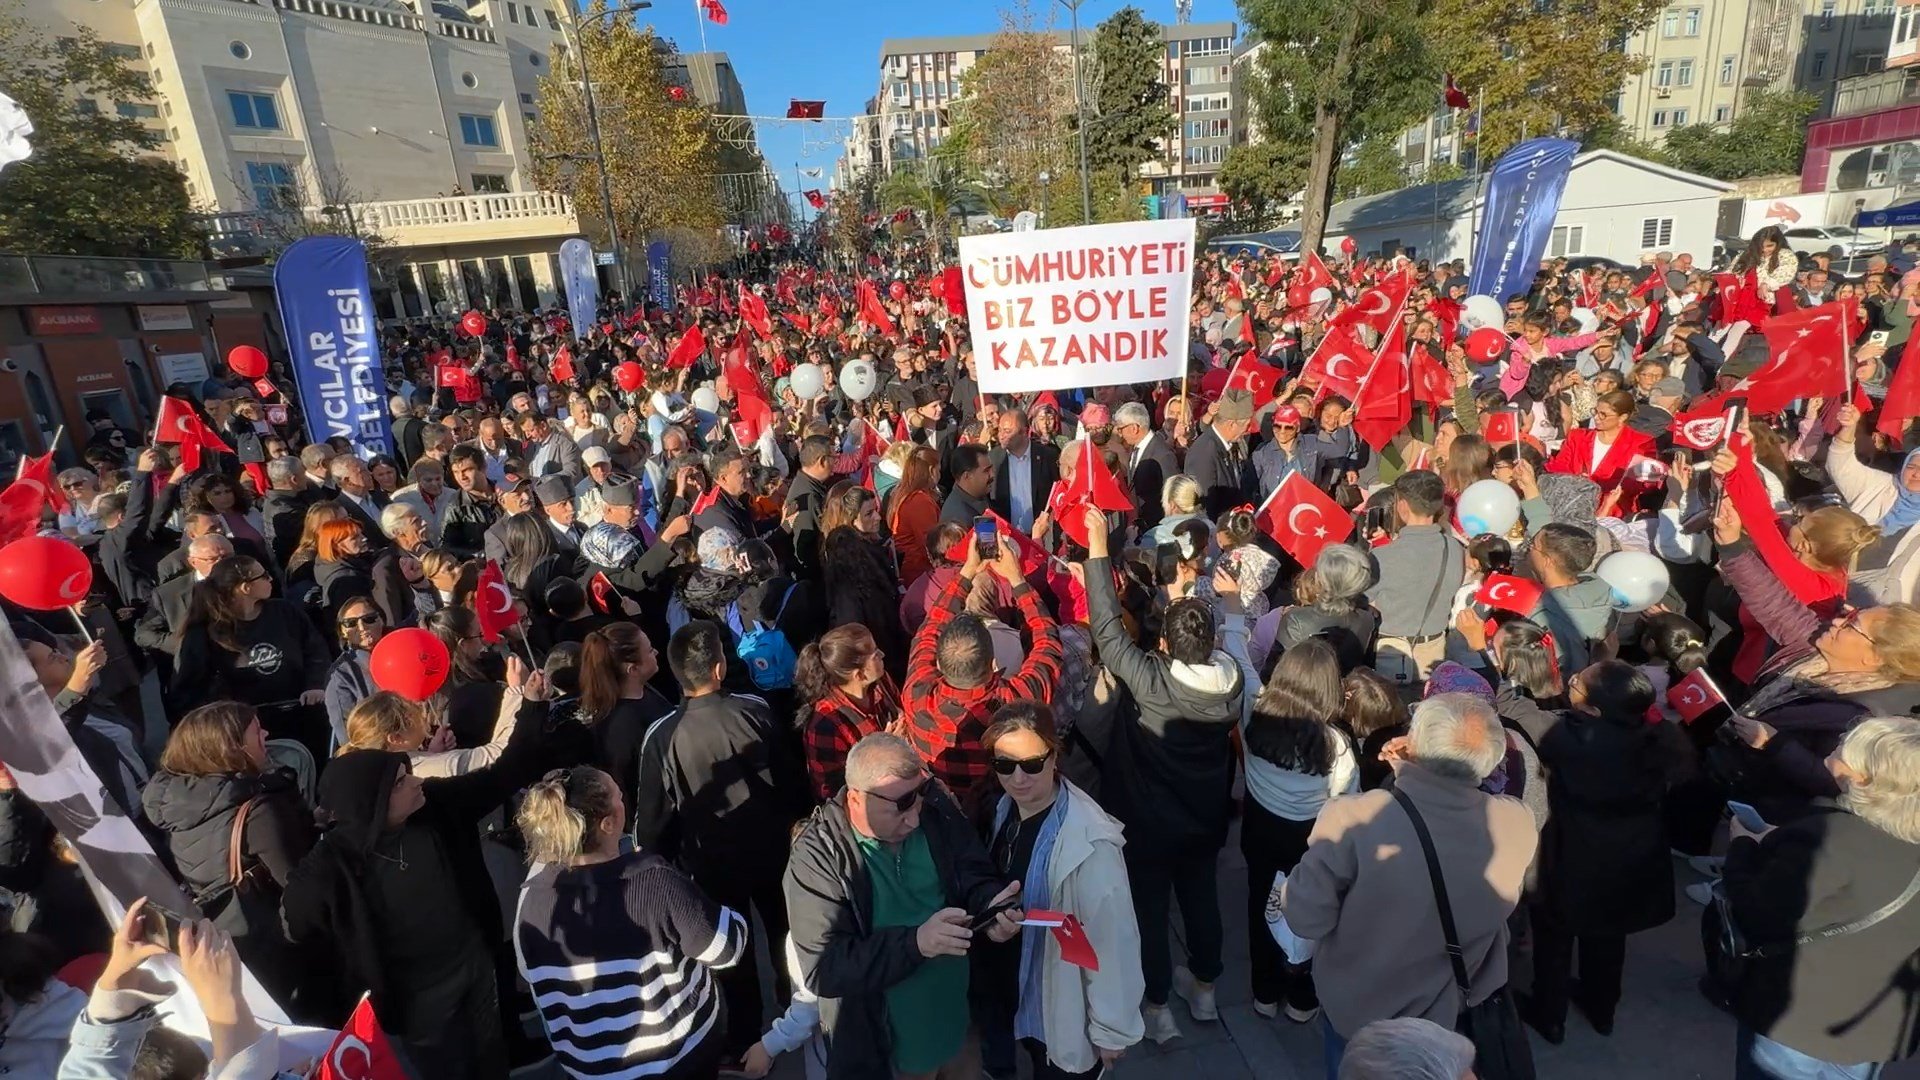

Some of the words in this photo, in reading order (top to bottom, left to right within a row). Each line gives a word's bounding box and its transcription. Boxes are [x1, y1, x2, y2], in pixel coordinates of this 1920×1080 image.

[1513, 149, 1546, 228] AVCILAR
[39, 314, 94, 325] AKBANK
[1051, 286, 1168, 325] BÖYLE
[990, 328, 1169, 371] KAZANDIK
[76, 372, 114, 383] AKBANK
[309, 331, 353, 437] VCILAR
[327, 287, 388, 456] BELEDİYESİ
